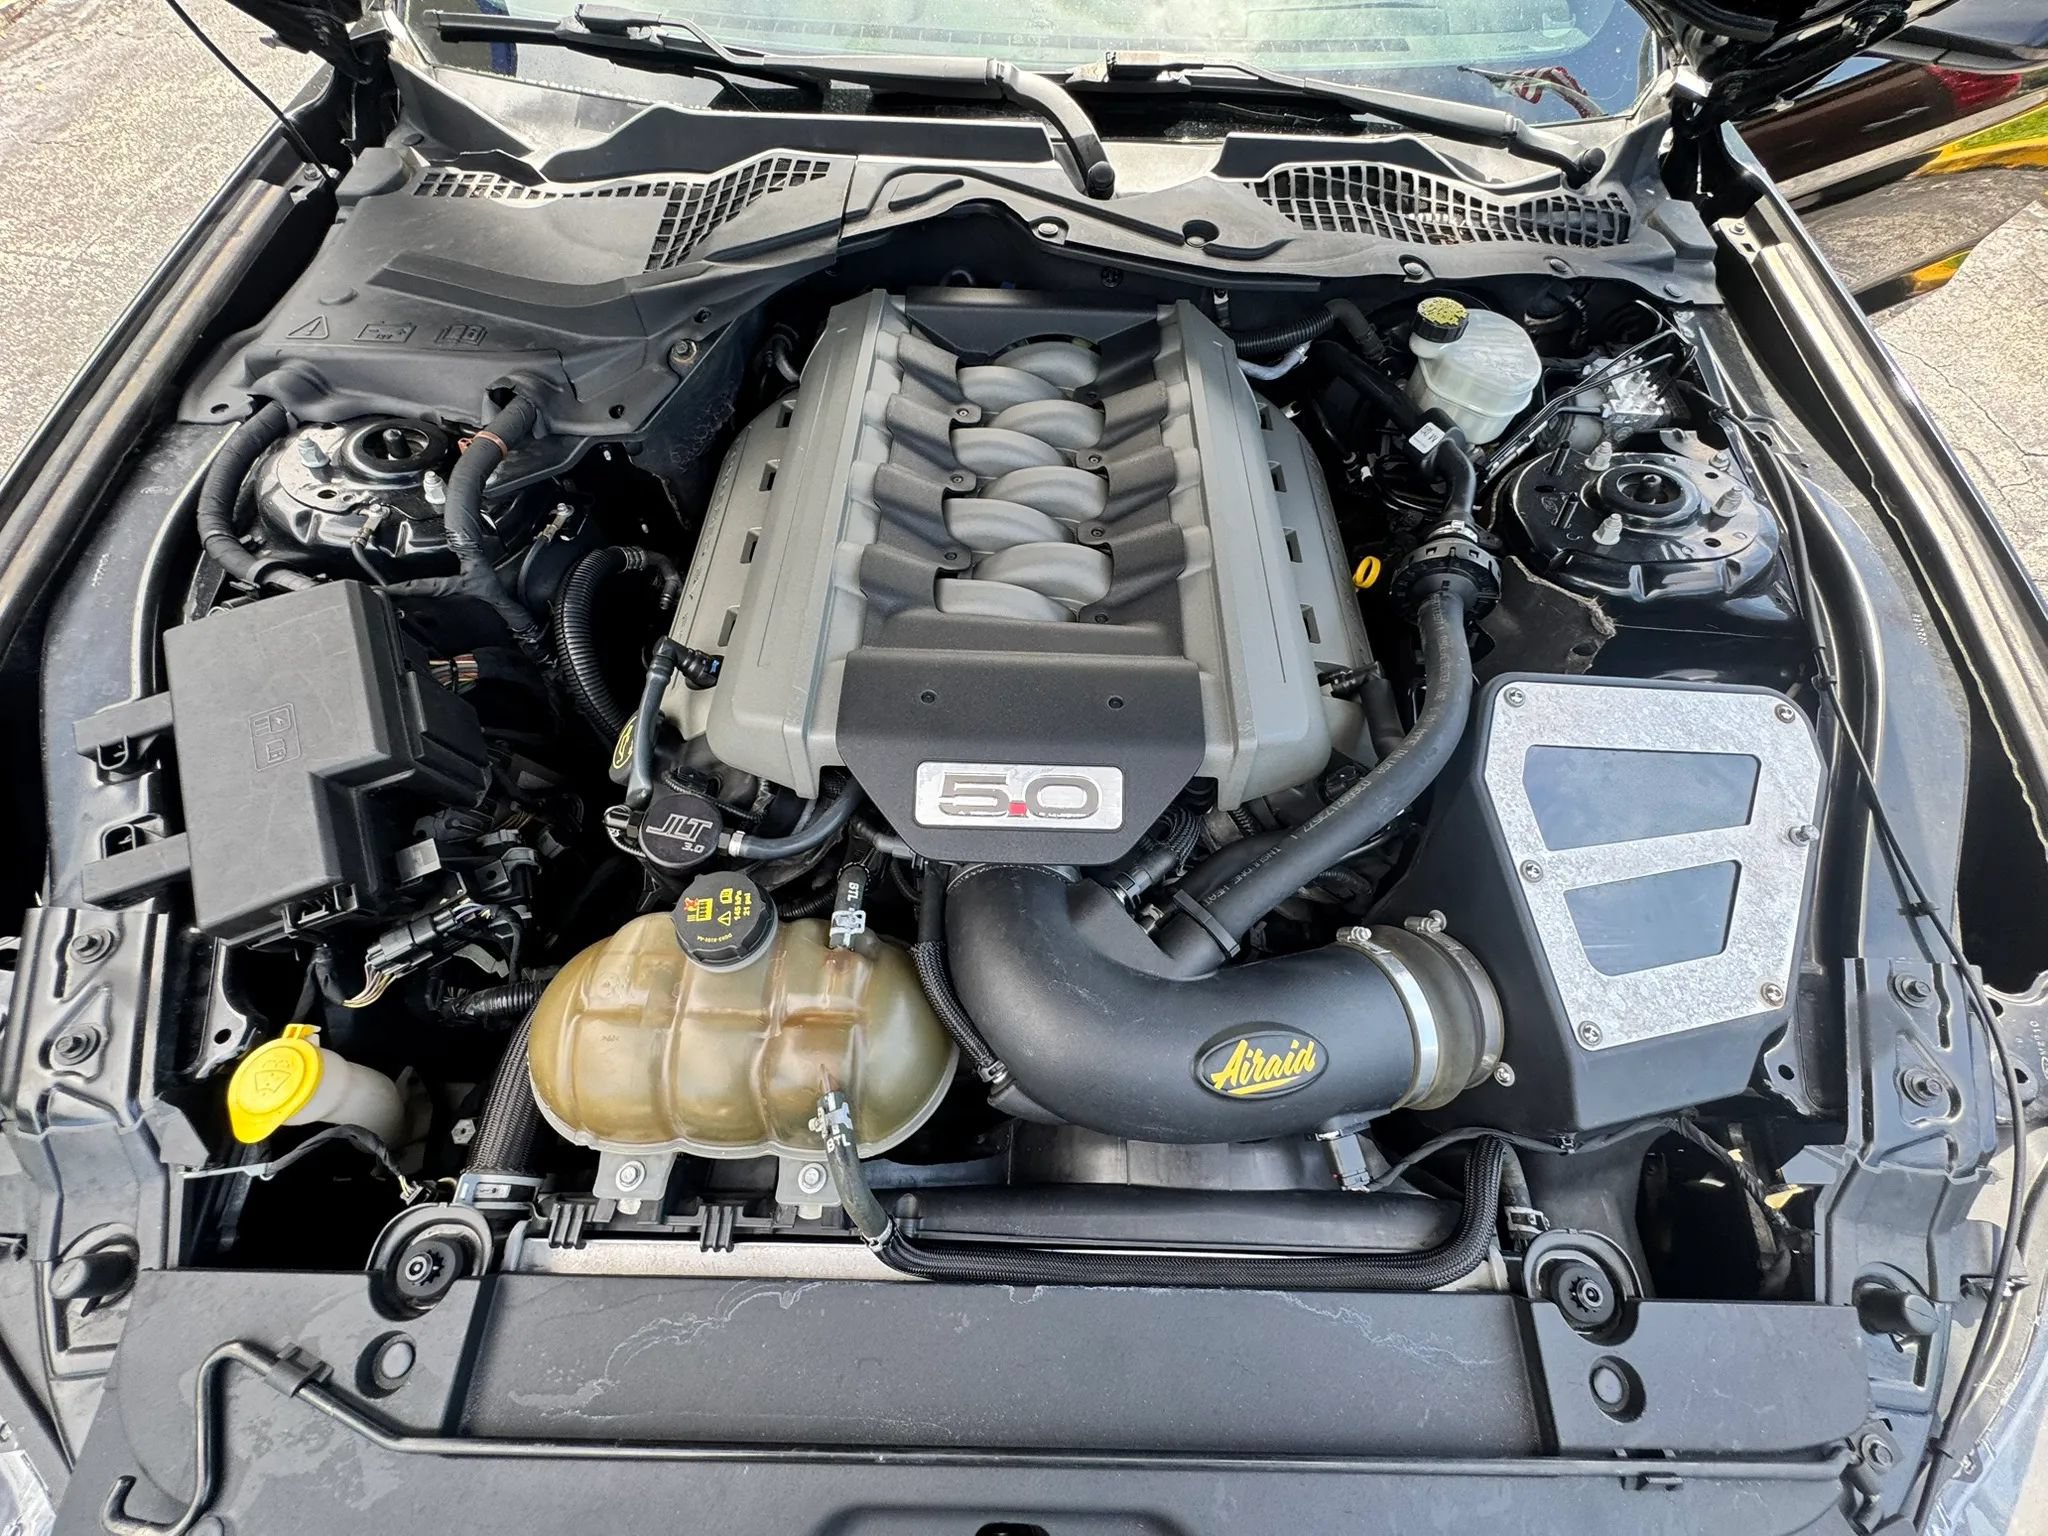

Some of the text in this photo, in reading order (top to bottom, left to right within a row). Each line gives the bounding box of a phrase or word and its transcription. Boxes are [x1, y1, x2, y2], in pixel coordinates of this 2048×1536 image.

[938, 772, 1101, 820] 5.0
[645, 813, 714, 843] JLT
[681, 841, 705, 854] 3.0
[847, 881, 860, 902] BTL
[733, 906, 742, 921] 145
[743, 906, 751, 917] 21
[1210, 1038, 1317, 1092] Airaid
[826, 1133, 852, 1154] BTL
